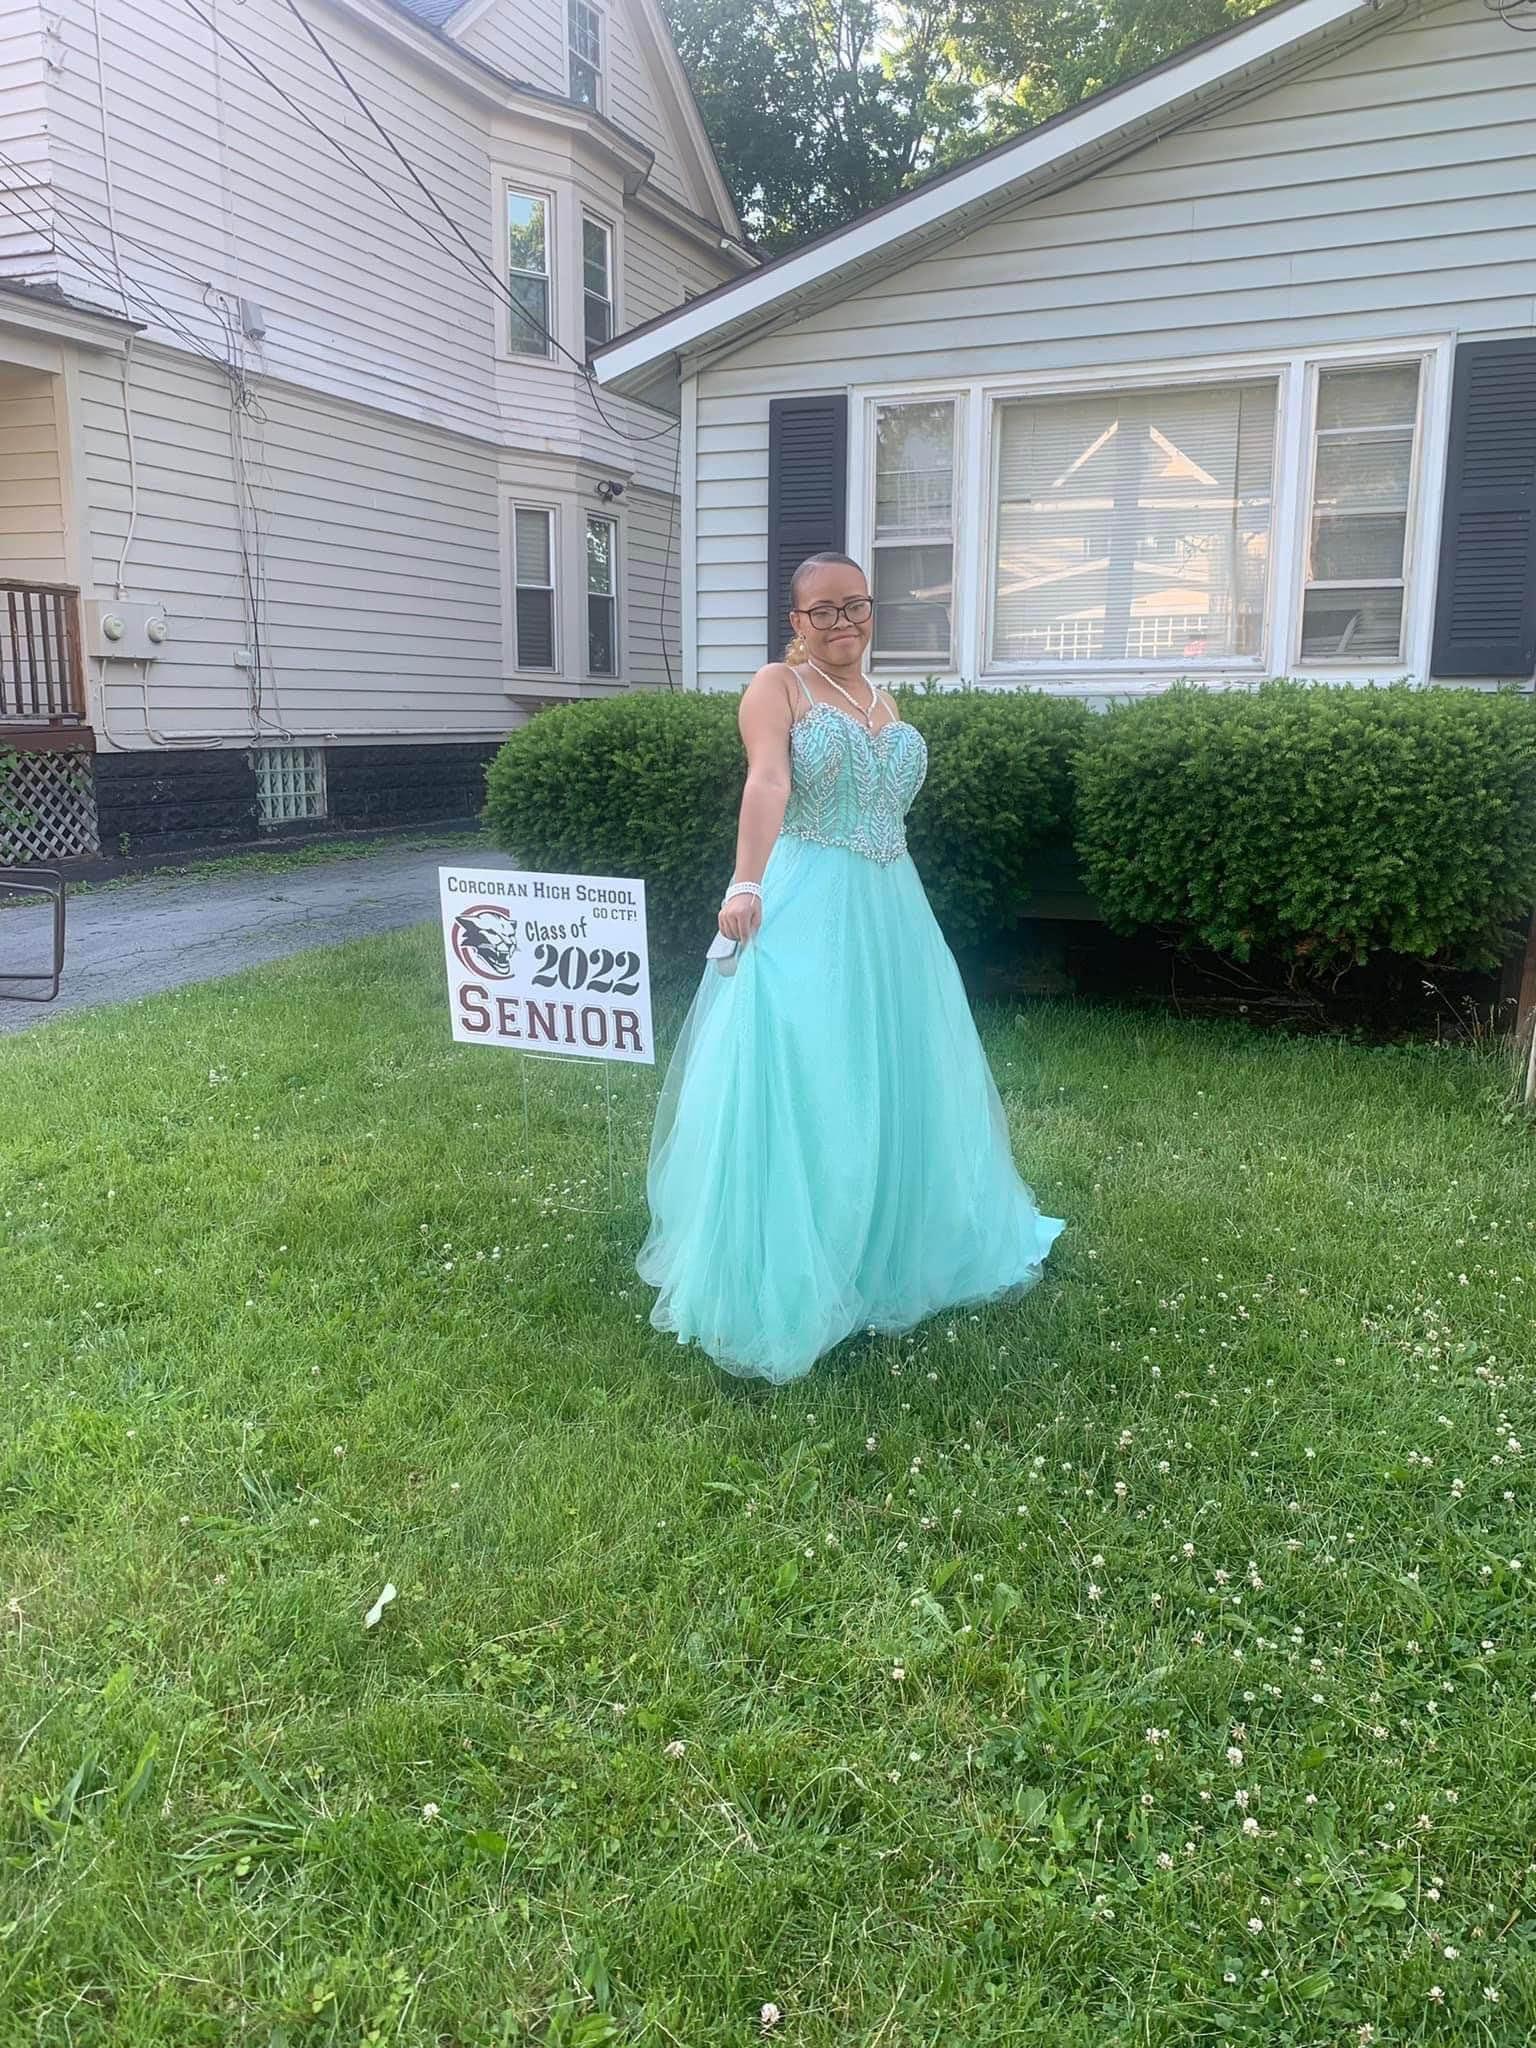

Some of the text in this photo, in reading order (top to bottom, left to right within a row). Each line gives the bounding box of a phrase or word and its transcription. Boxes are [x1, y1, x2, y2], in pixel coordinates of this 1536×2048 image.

[447, 876, 636, 905] CORCORAN HIGH SCHOOL
[592, 907, 608, 919] GO
[525, 916, 588, 942] Class of
[531, 943, 641, 996] 2022
[458, 984, 643, 1051] SENIOR
